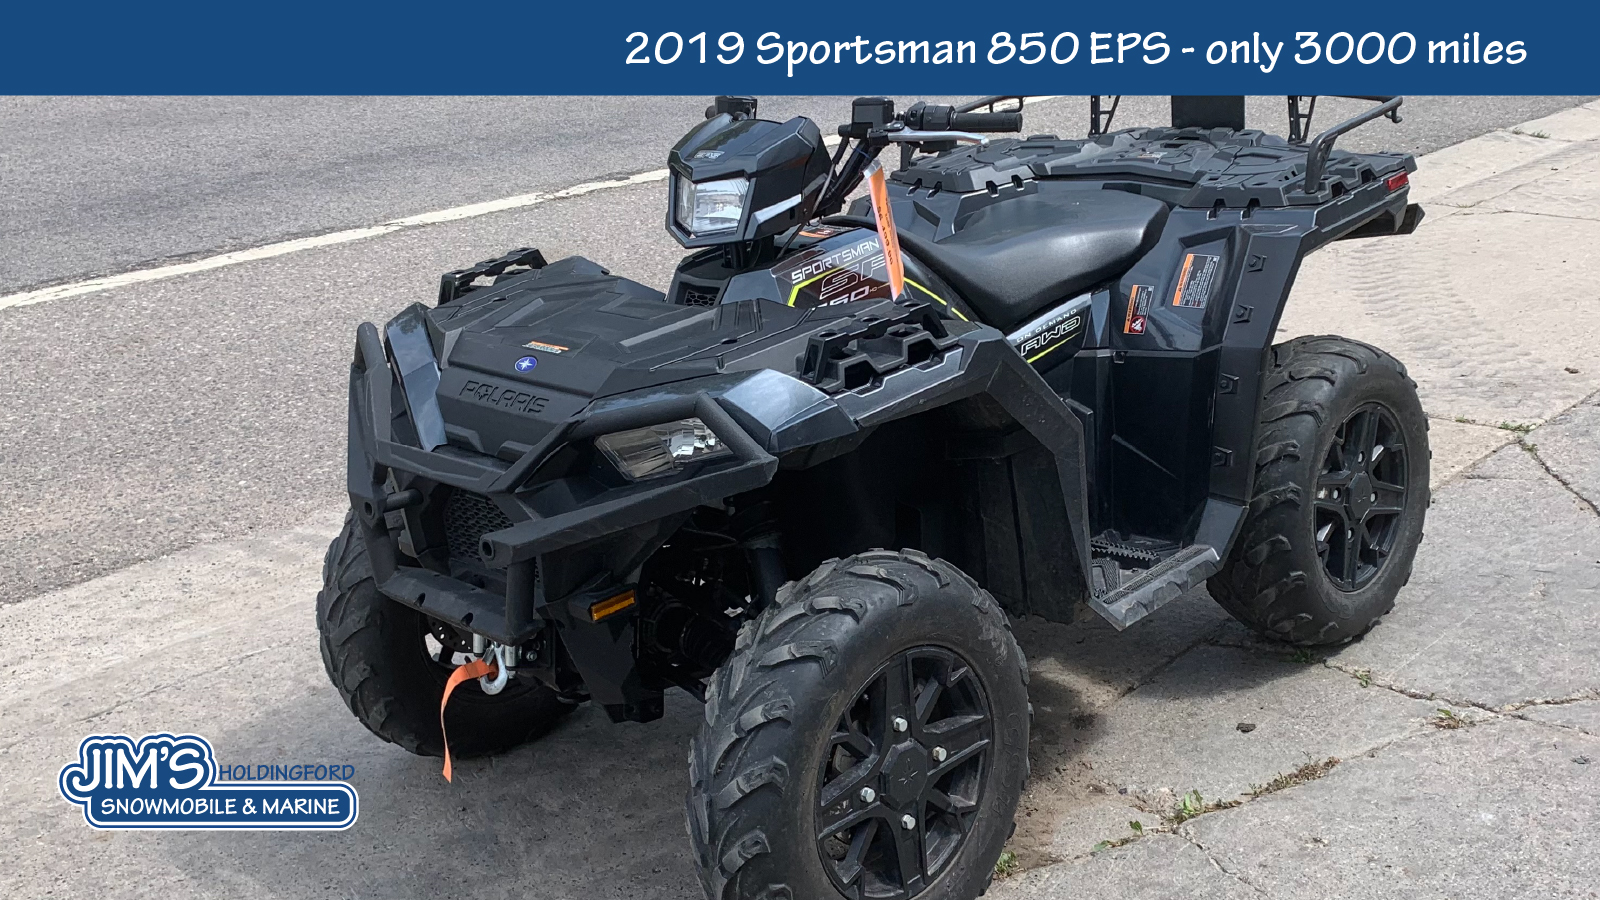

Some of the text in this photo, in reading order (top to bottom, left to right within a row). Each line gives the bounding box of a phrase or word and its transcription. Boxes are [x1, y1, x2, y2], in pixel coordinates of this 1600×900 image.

[791, 238, 880, 285] SPORTSMAN
[1016, 308, 1077, 343] ON DEMAND
[1020, 315, 1081, 357] AWD
[459, 380, 550, 413] POLARIS
